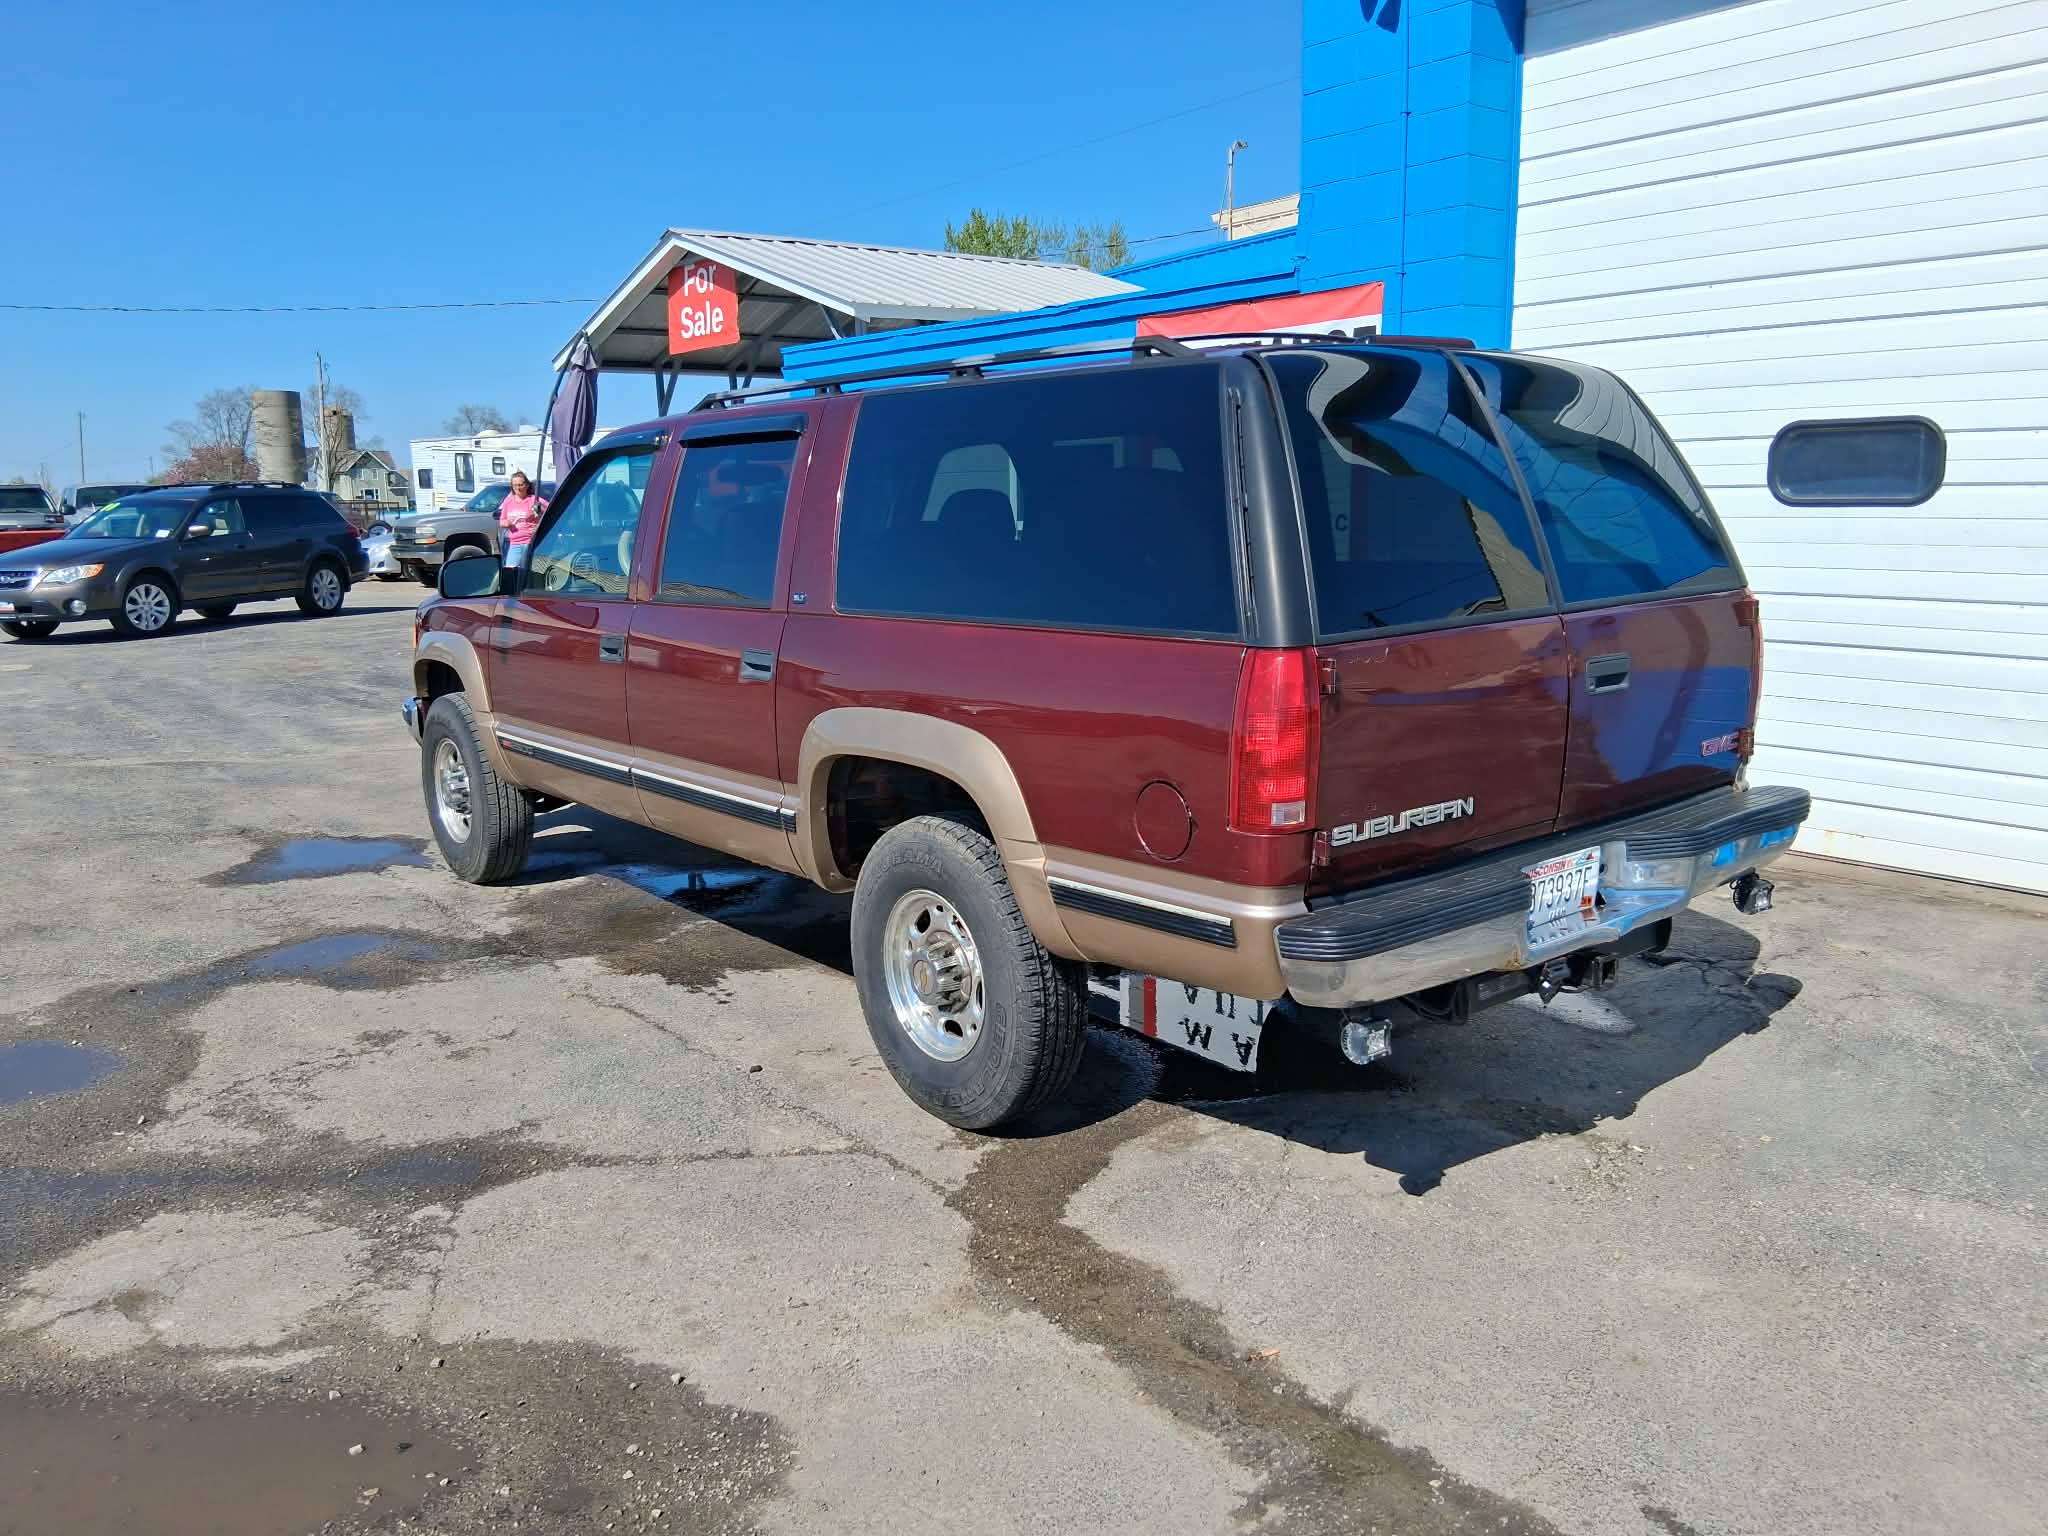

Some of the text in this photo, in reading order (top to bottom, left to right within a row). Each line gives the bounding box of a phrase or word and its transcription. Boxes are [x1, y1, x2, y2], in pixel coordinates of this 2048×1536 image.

[684, 264, 717, 296] For
[681, 301, 724, 339] Sale
[1702, 732, 1739, 757] GMC
[1331, 796, 1475, 847] SUBURBAN
